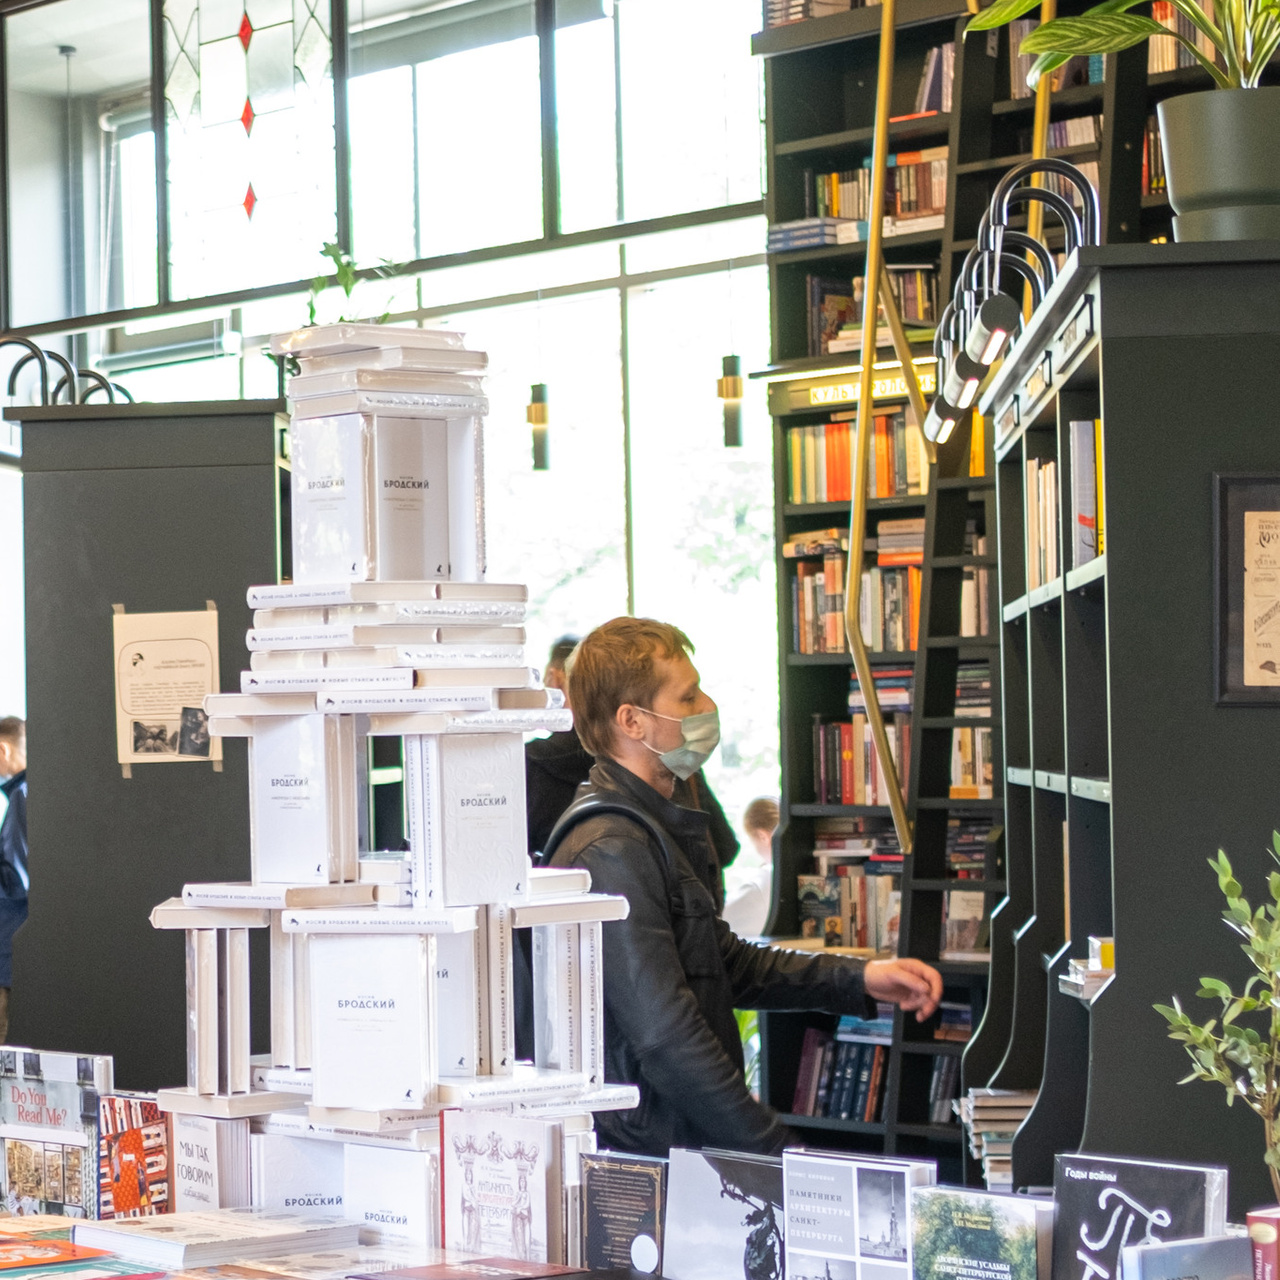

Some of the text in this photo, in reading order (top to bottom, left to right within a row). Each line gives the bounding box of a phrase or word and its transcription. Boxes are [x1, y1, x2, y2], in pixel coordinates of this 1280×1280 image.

[308, 477, 345, 489] БРОДСКИЙ
[384, 477, 429, 489] БРОДСКИЙ
[272, 777, 309, 787] БРОДСКИЙ
[461, 796, 507, 807] БРОДСКИЙ
[338, 998, 396, 1009] БРОДСКИЙ
[11, 1085, 46, 1107] Do You
[17, 1105, 67, 1126] Read Me?
[180, 1141, 210, 1163] МЫ ТАК
[177, 1164, 213, 1188] ГОВОРИМ
[1065, 1168, 1116, 1182] Годы войны
[285, 1196, 342, 1207] БРОДСКИЙ
[789, 1189, 842, 1202] ПАМЯТНИКИ
[789, 1202, 851, 1217] АРХИТЕКТУРЫ
[364, 1212, 407, 1225] БРОДСКИЙ
[790, 1216, 820, 1226] САНКТ-
[790, 1229, 844, 1244] ПЕТЕРБУРГА
